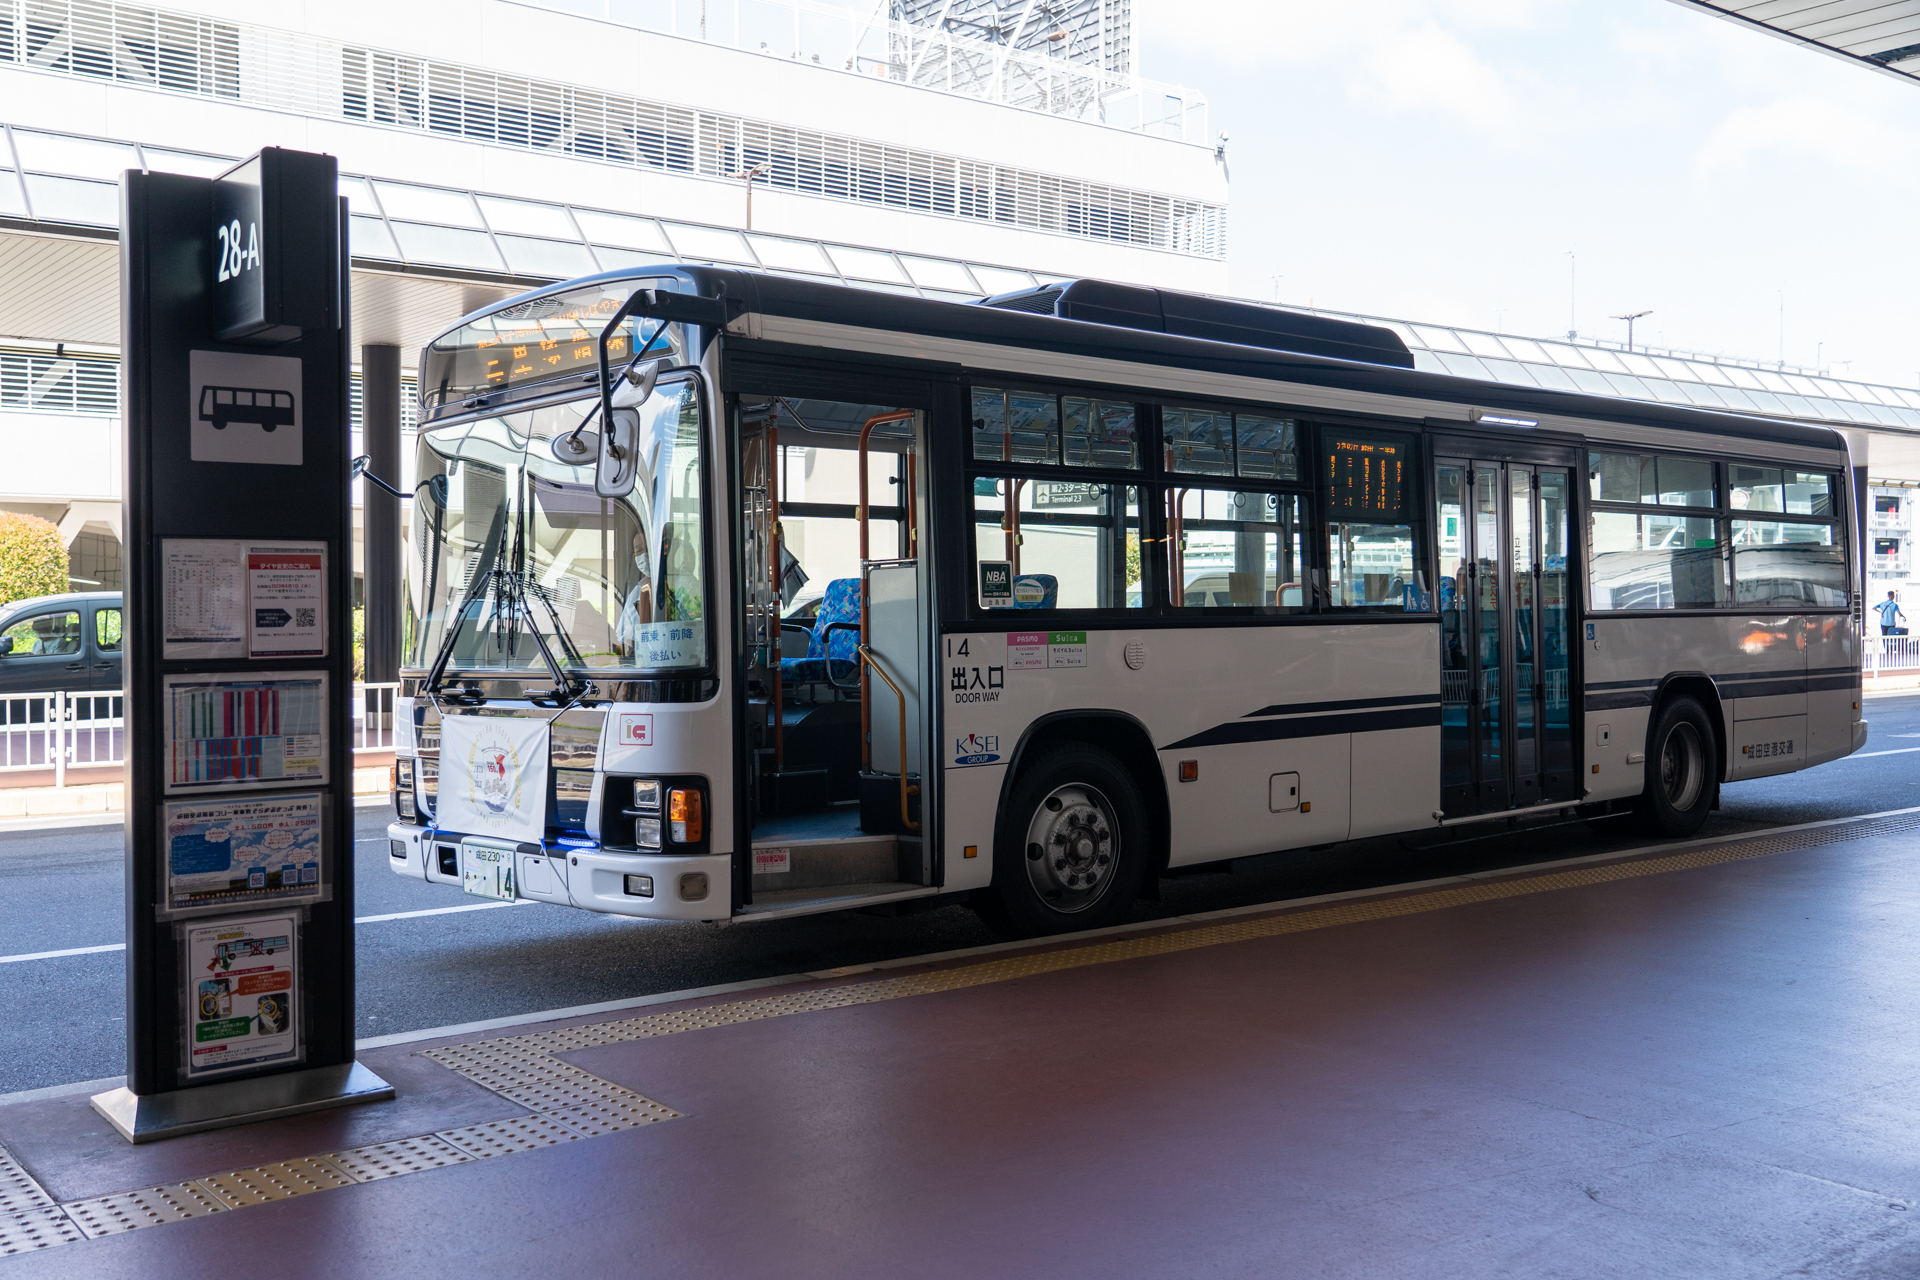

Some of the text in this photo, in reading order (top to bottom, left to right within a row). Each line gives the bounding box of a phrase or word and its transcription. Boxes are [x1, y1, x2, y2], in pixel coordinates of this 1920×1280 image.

[218, 218, 260, 283] 28-A
[1073, 495, 1082, 503] 2,3
[986, 571, 1006, 582] NBA
[640, 628, 694, 642] 前乗・前降
[1016, 635, 1039, 643] PASMO
[1056, 634, 1078, 642] Suica
[948, 638, 970, 658] 14
[649, 650, 682, 662] 後払い
[951, 665, 1004, 691] 出入口
[955, 691, 1000, 703] DOOR WAY
[475, 724, 493, 742] CHIBA
[1747, 740, 1793, 760] 成田空港交通
[967, 755, 989, 763] GROUP
[479, 811, 514, 829] ANNIVERSARY
[476, 850, 501, 862] 成田 230
